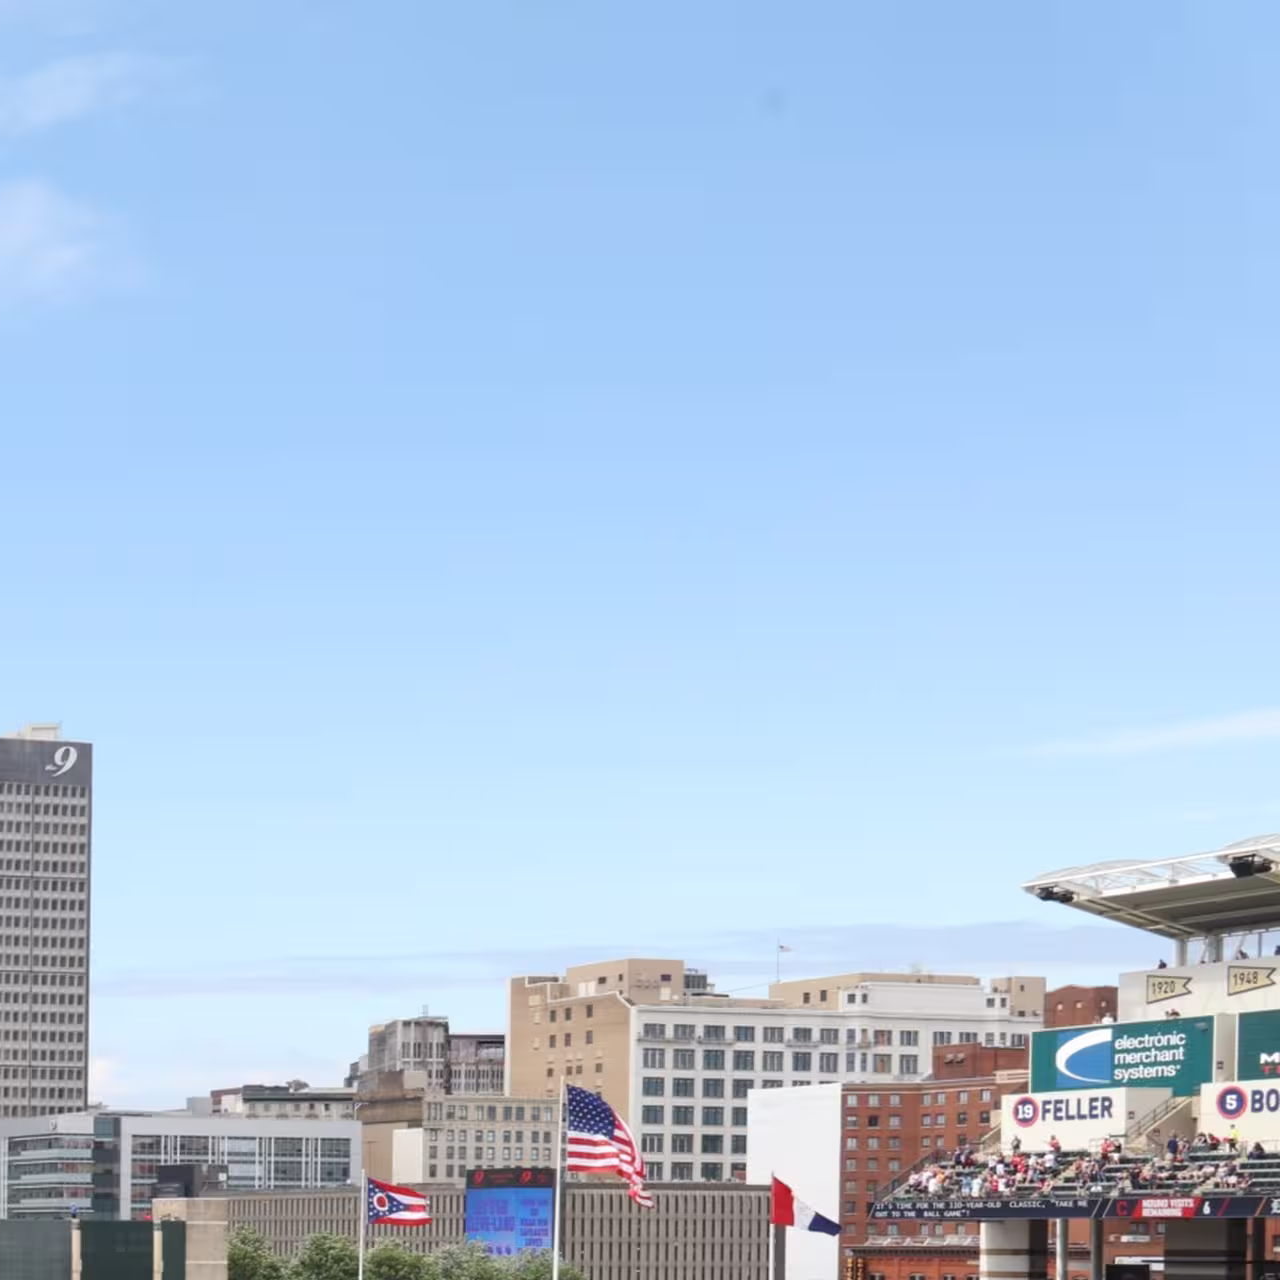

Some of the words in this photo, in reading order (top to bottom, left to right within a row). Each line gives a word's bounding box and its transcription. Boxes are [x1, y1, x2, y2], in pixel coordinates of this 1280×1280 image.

[1151, 980, 1176, 995] 1920
[1232, 971, 1258, 986] 1948
[1114, 1031, 1187, 1051] electronic
[1114, 1046, 1185, 1065] merchant
[1114, 1065, 1177, 1083] systems
[1017, 1104, 1034, 1120] 19
[1041, 1096, 1114, 1122] FELLER
[1202, 1201, 1211, 1215] 6
